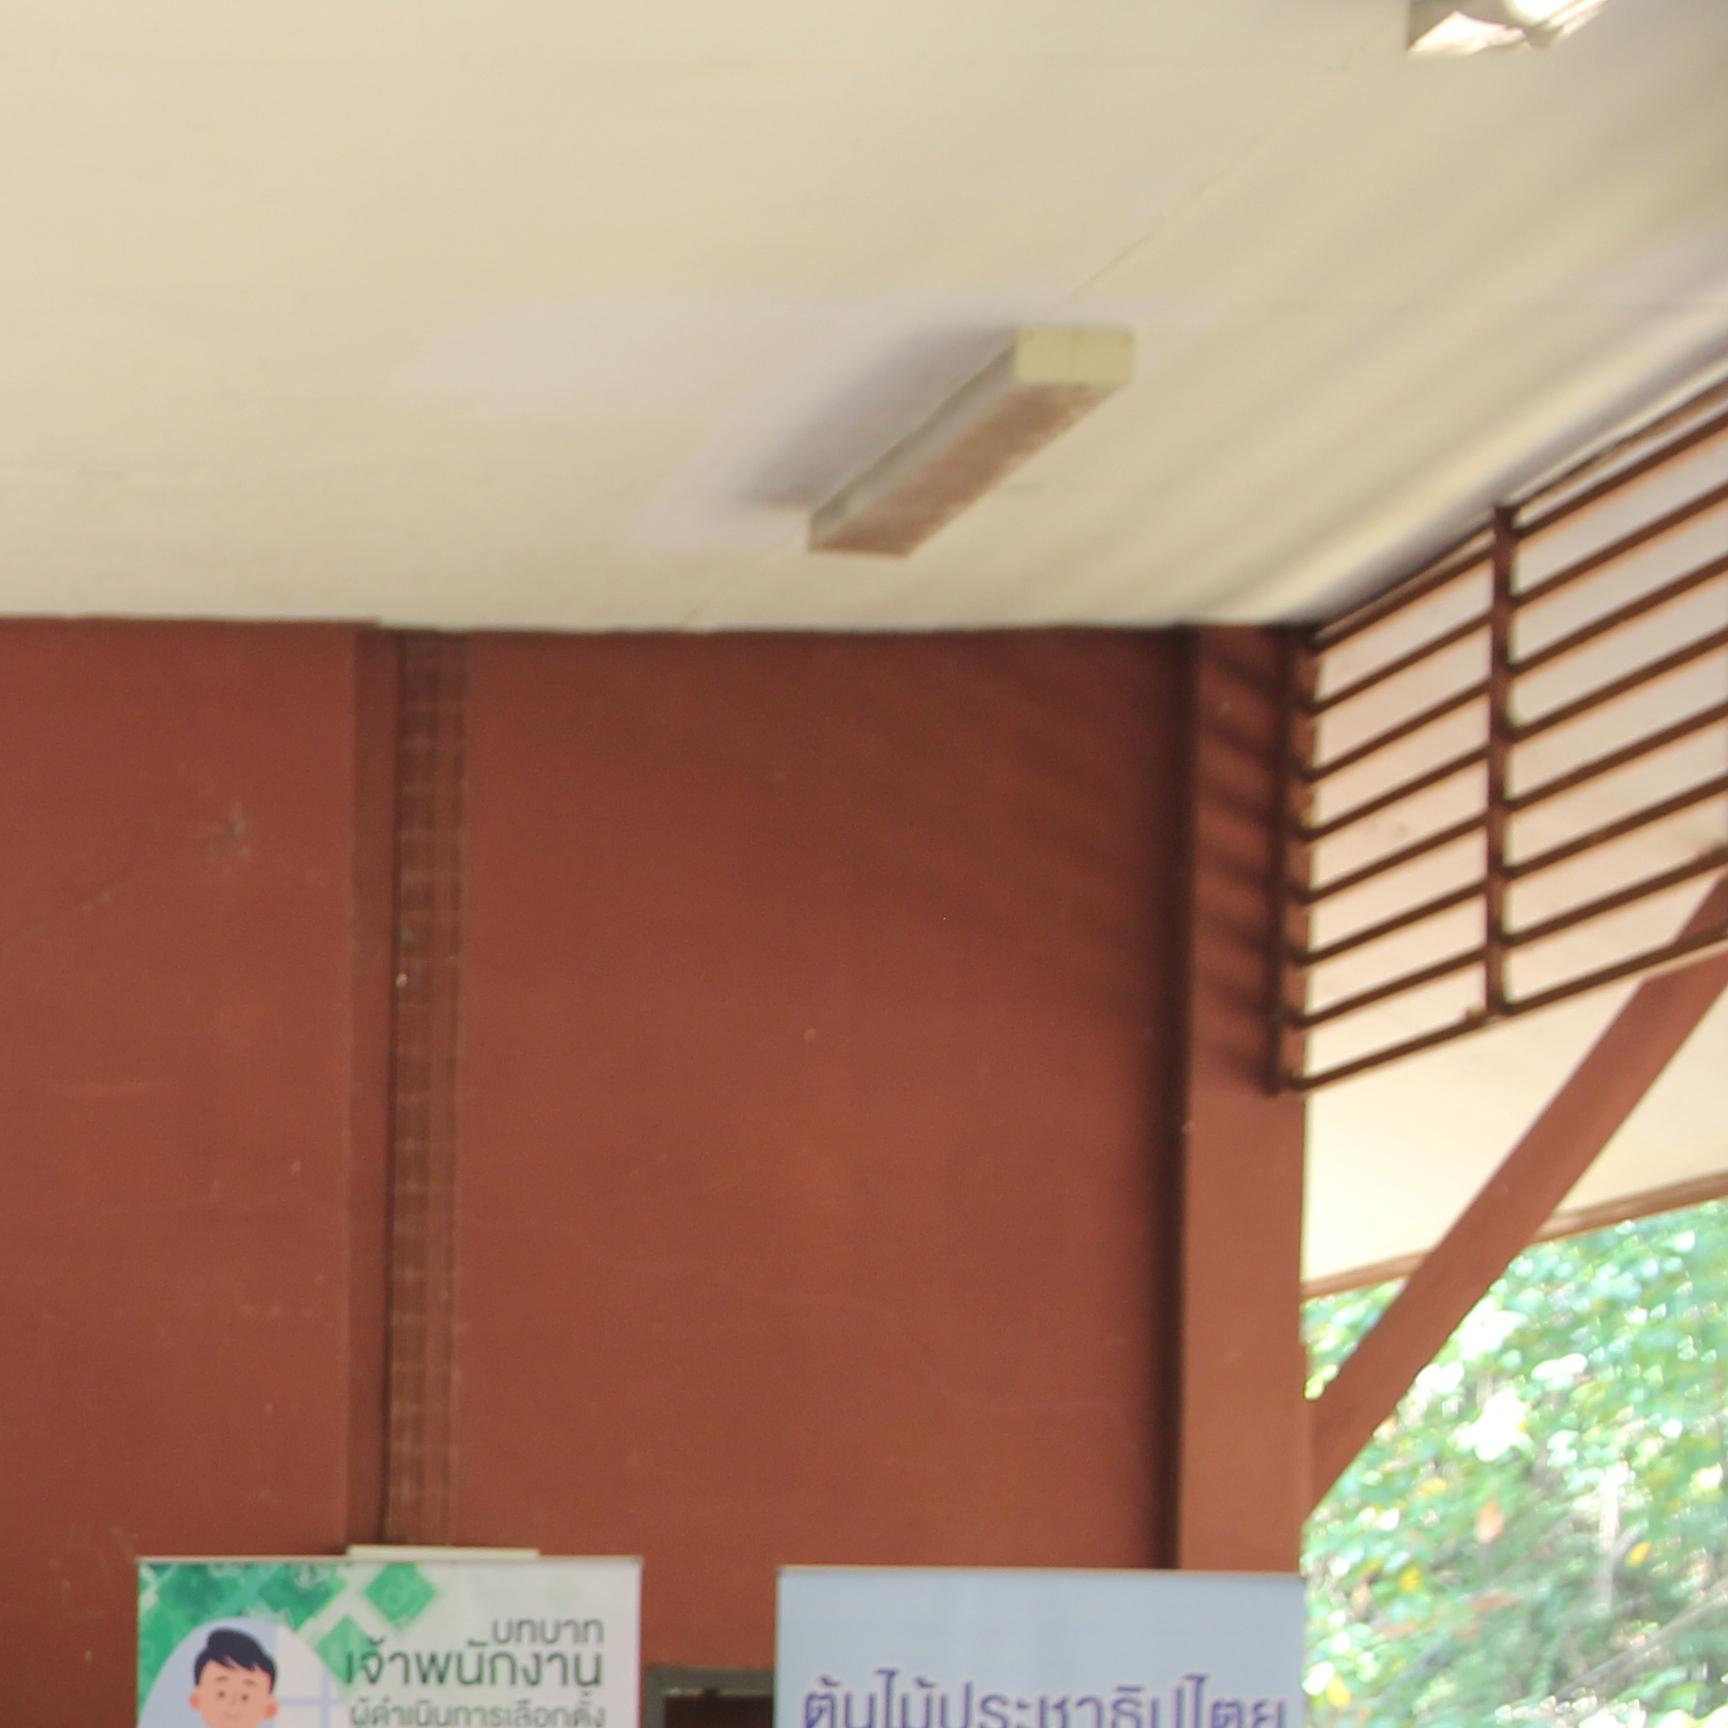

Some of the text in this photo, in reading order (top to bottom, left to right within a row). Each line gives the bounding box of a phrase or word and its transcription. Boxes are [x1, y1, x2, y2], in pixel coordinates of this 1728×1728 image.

[492, 1616, 605, 1646] บทบาท
[345, 1637, 604, 1688] เจ้าพนักงาน
